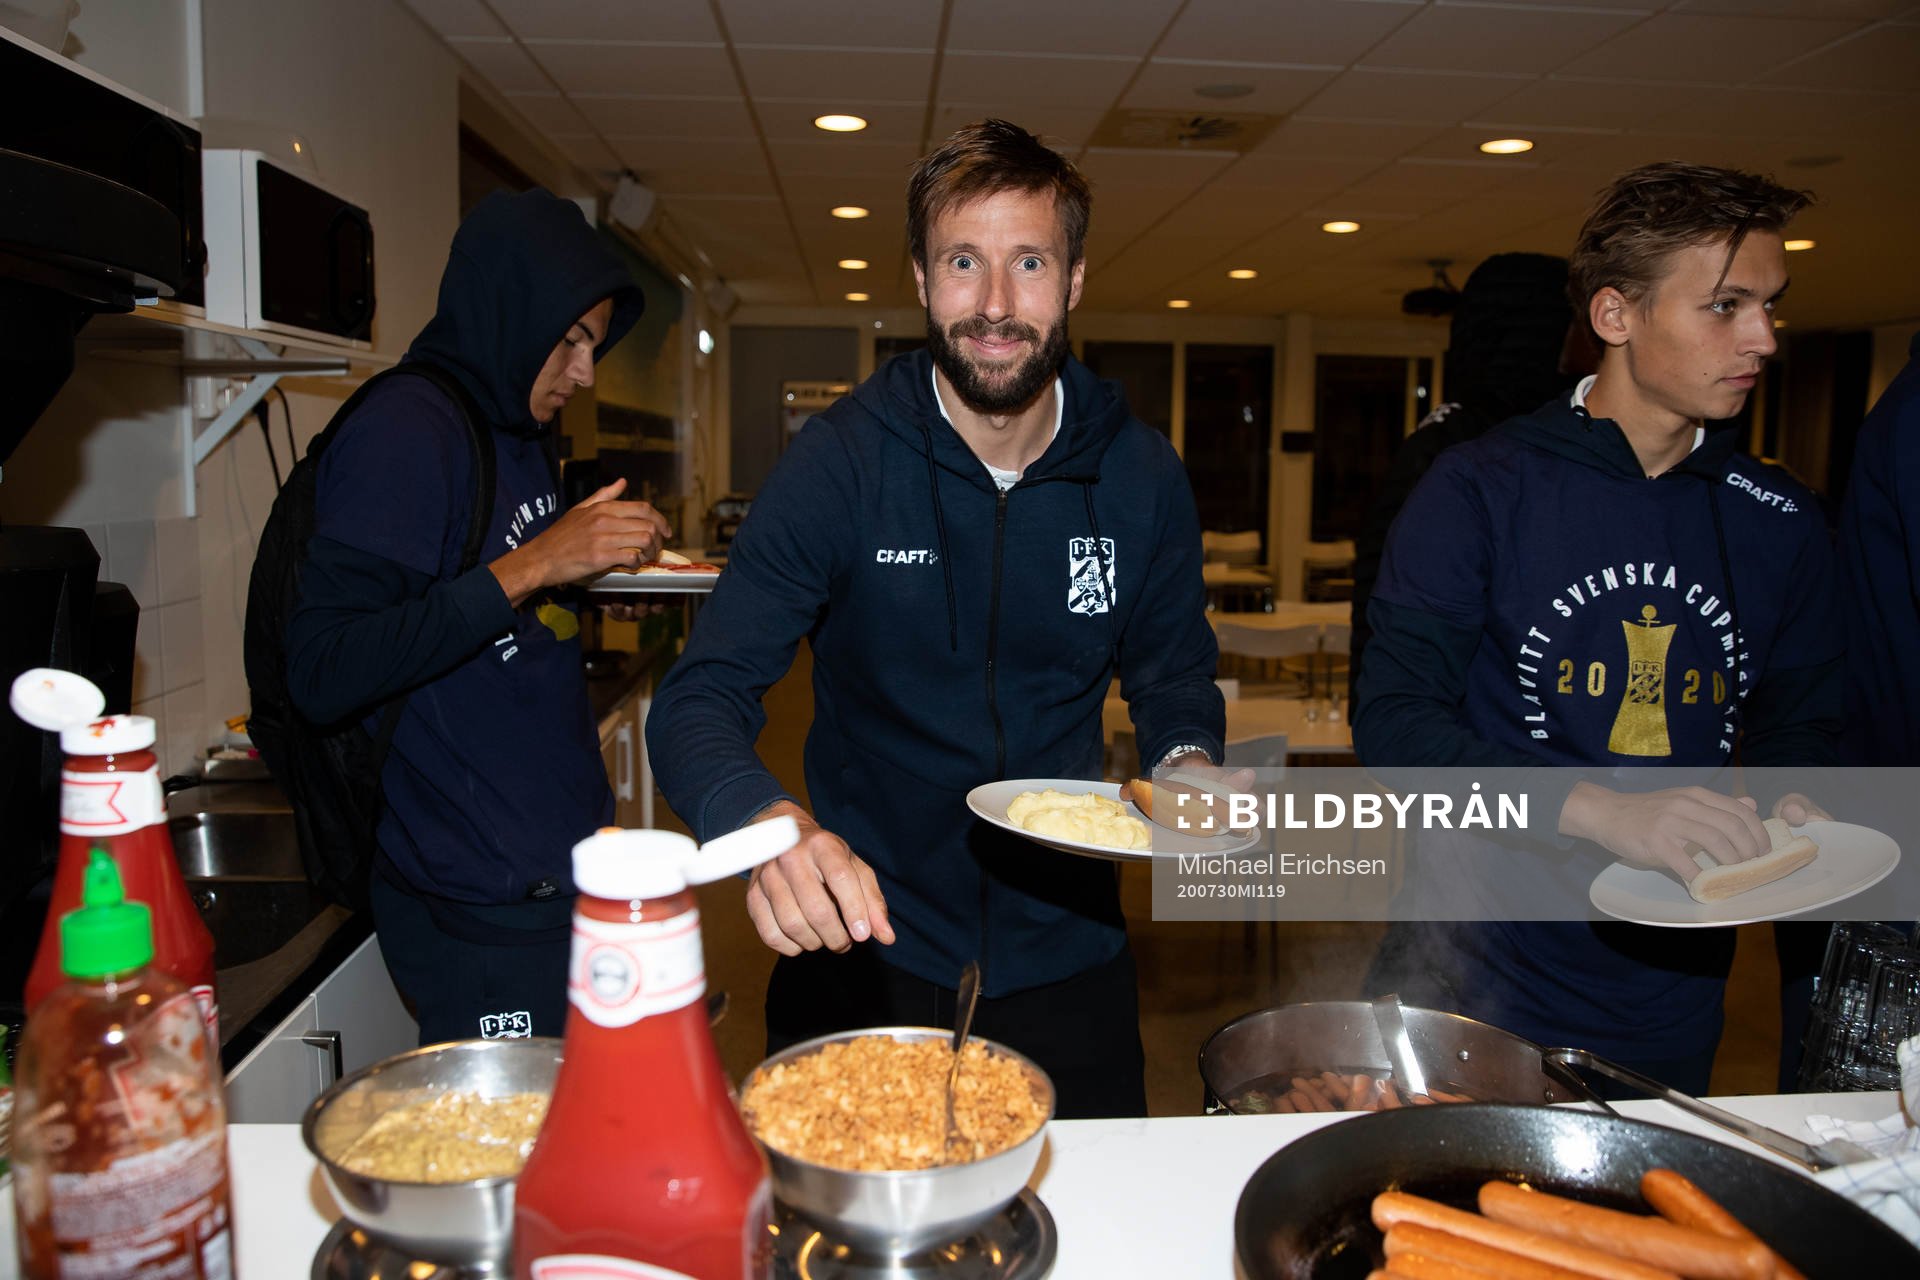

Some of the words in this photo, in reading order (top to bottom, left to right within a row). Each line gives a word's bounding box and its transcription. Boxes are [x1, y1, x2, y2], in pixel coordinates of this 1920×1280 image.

[1726, 472, 1785, 506] CRAFT
[876, 549, 928, 564] CRAFT
[1552, 562, 1677, 618] SVENSKA
